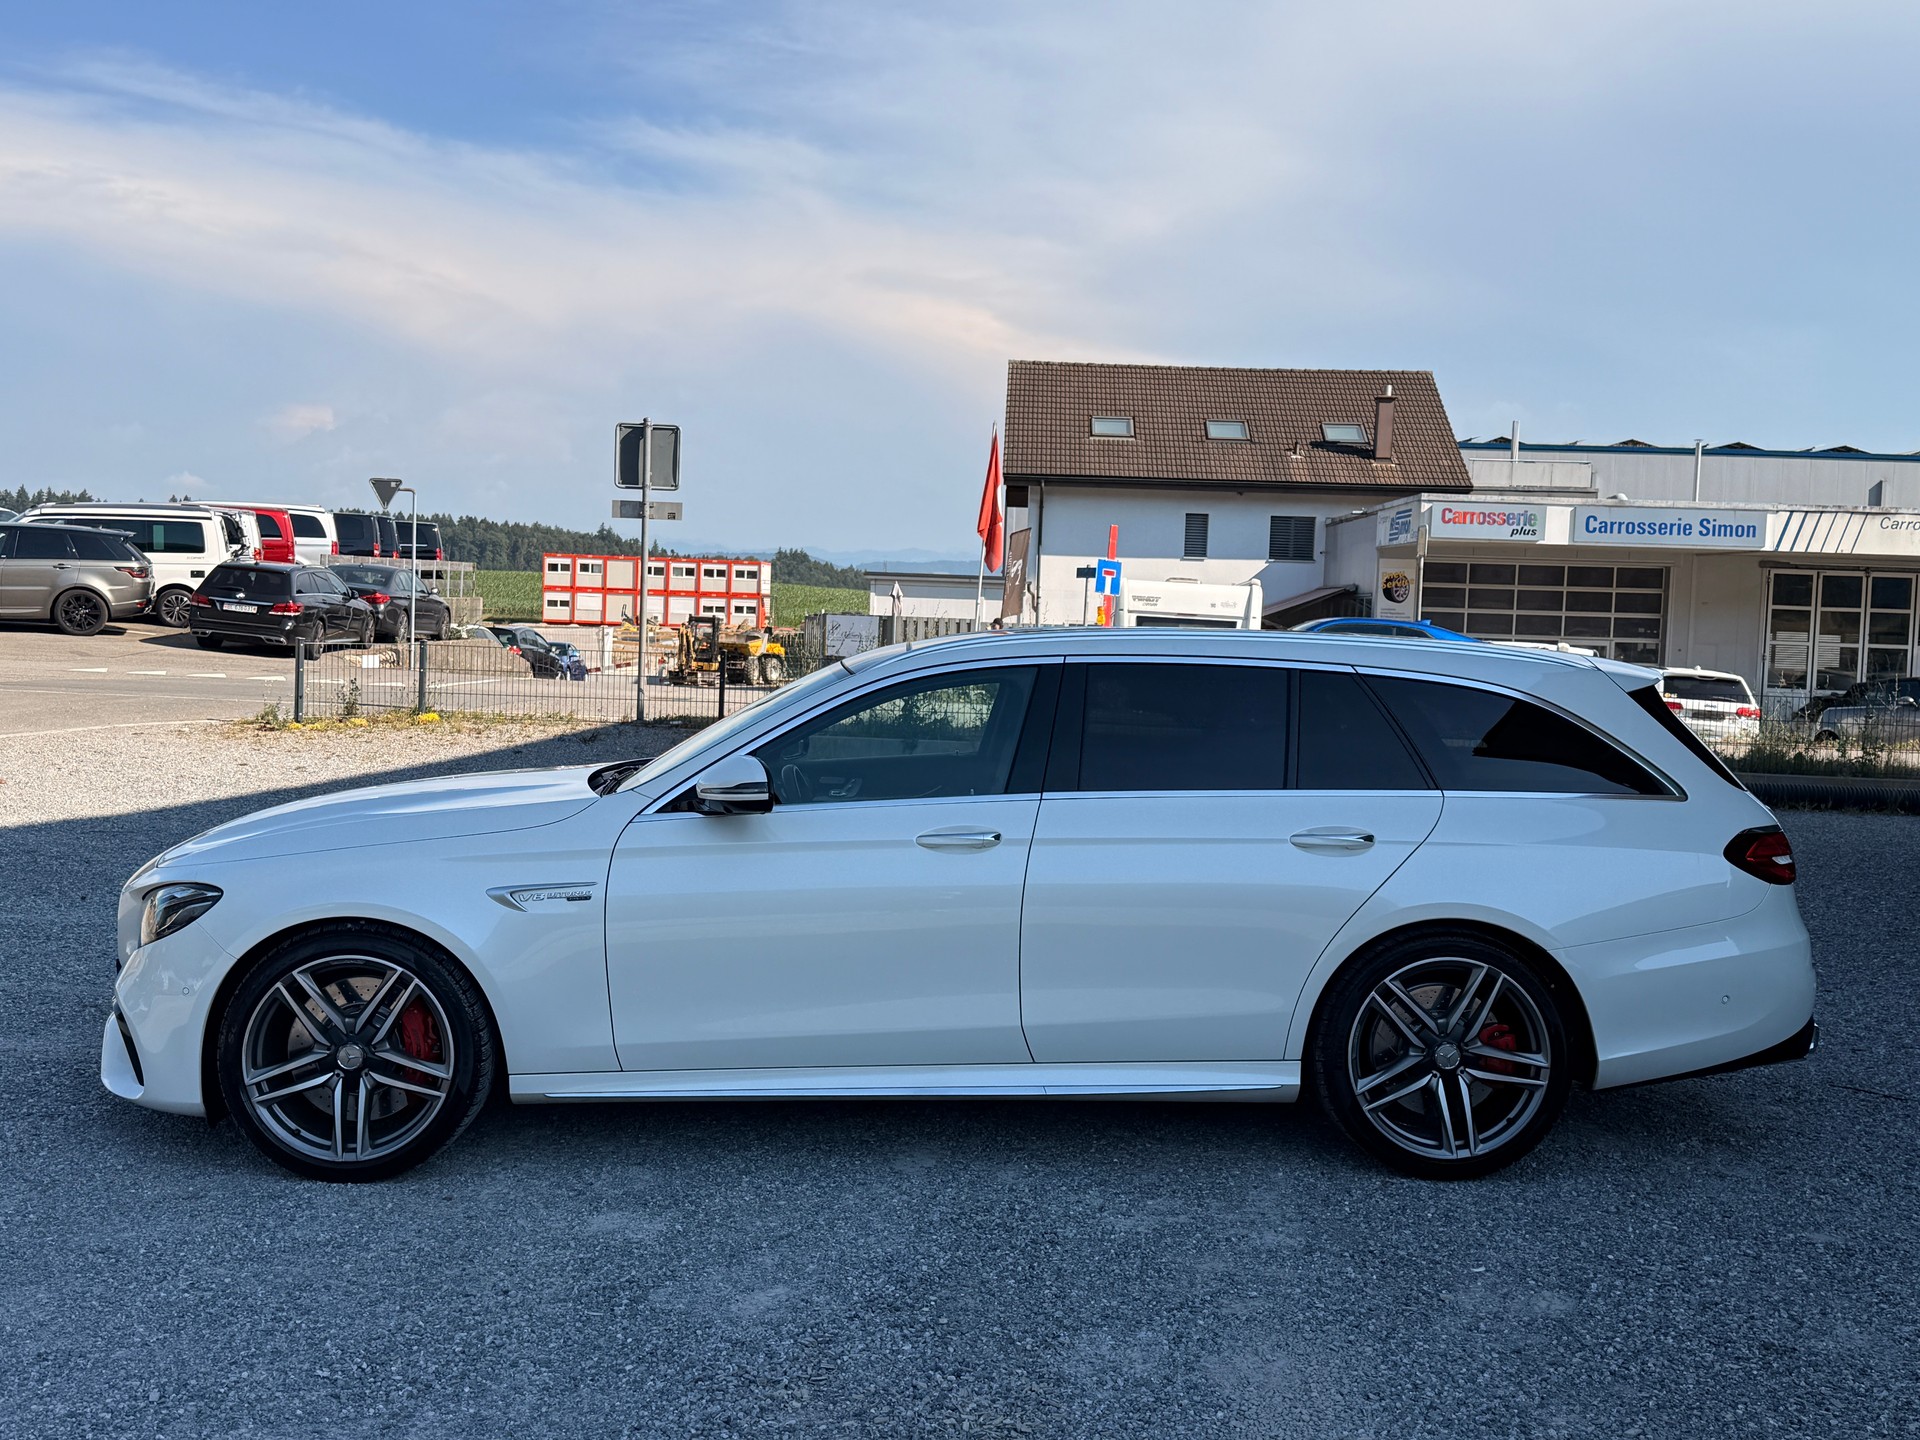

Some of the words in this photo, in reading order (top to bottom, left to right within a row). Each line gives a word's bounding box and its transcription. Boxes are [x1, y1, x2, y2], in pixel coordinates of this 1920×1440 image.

[1441, 507, 1538, 527] Carrosserie
[1880, 516, 1920, 530] Carro
[1510, 526, 1537, 537] plus
[1585, 515, 1693, 536] Carrosserie
[1698, 518, 1757, 538] Simon
